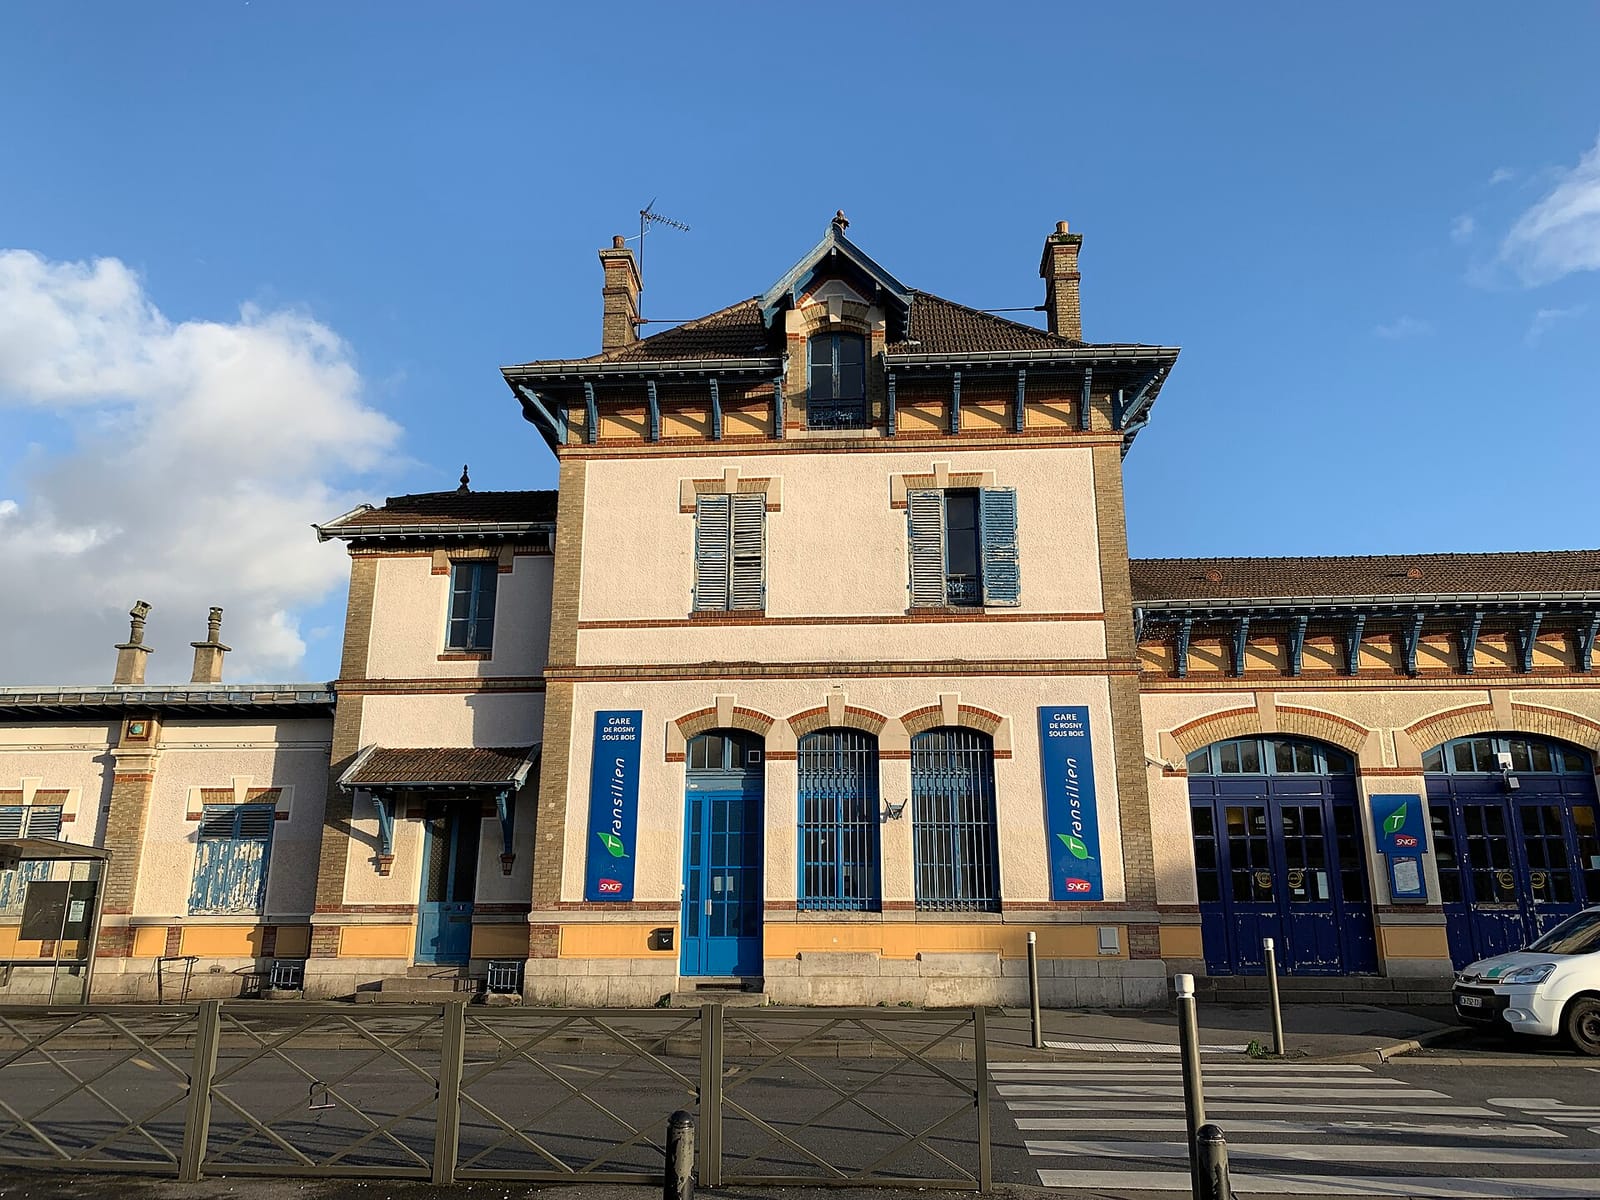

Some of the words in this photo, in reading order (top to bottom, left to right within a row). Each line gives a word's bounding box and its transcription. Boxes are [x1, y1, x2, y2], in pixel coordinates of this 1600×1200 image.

[608, 717, 631, 725] GARE
[1053, 713, 1077, 721] GARE
[1392, 815, 1404, 829] T
[1396, 838, 1417, 846] SNCF
[599, 883, 623, 891] SNCF
[1067, 882, 1090, 891] SNCF
